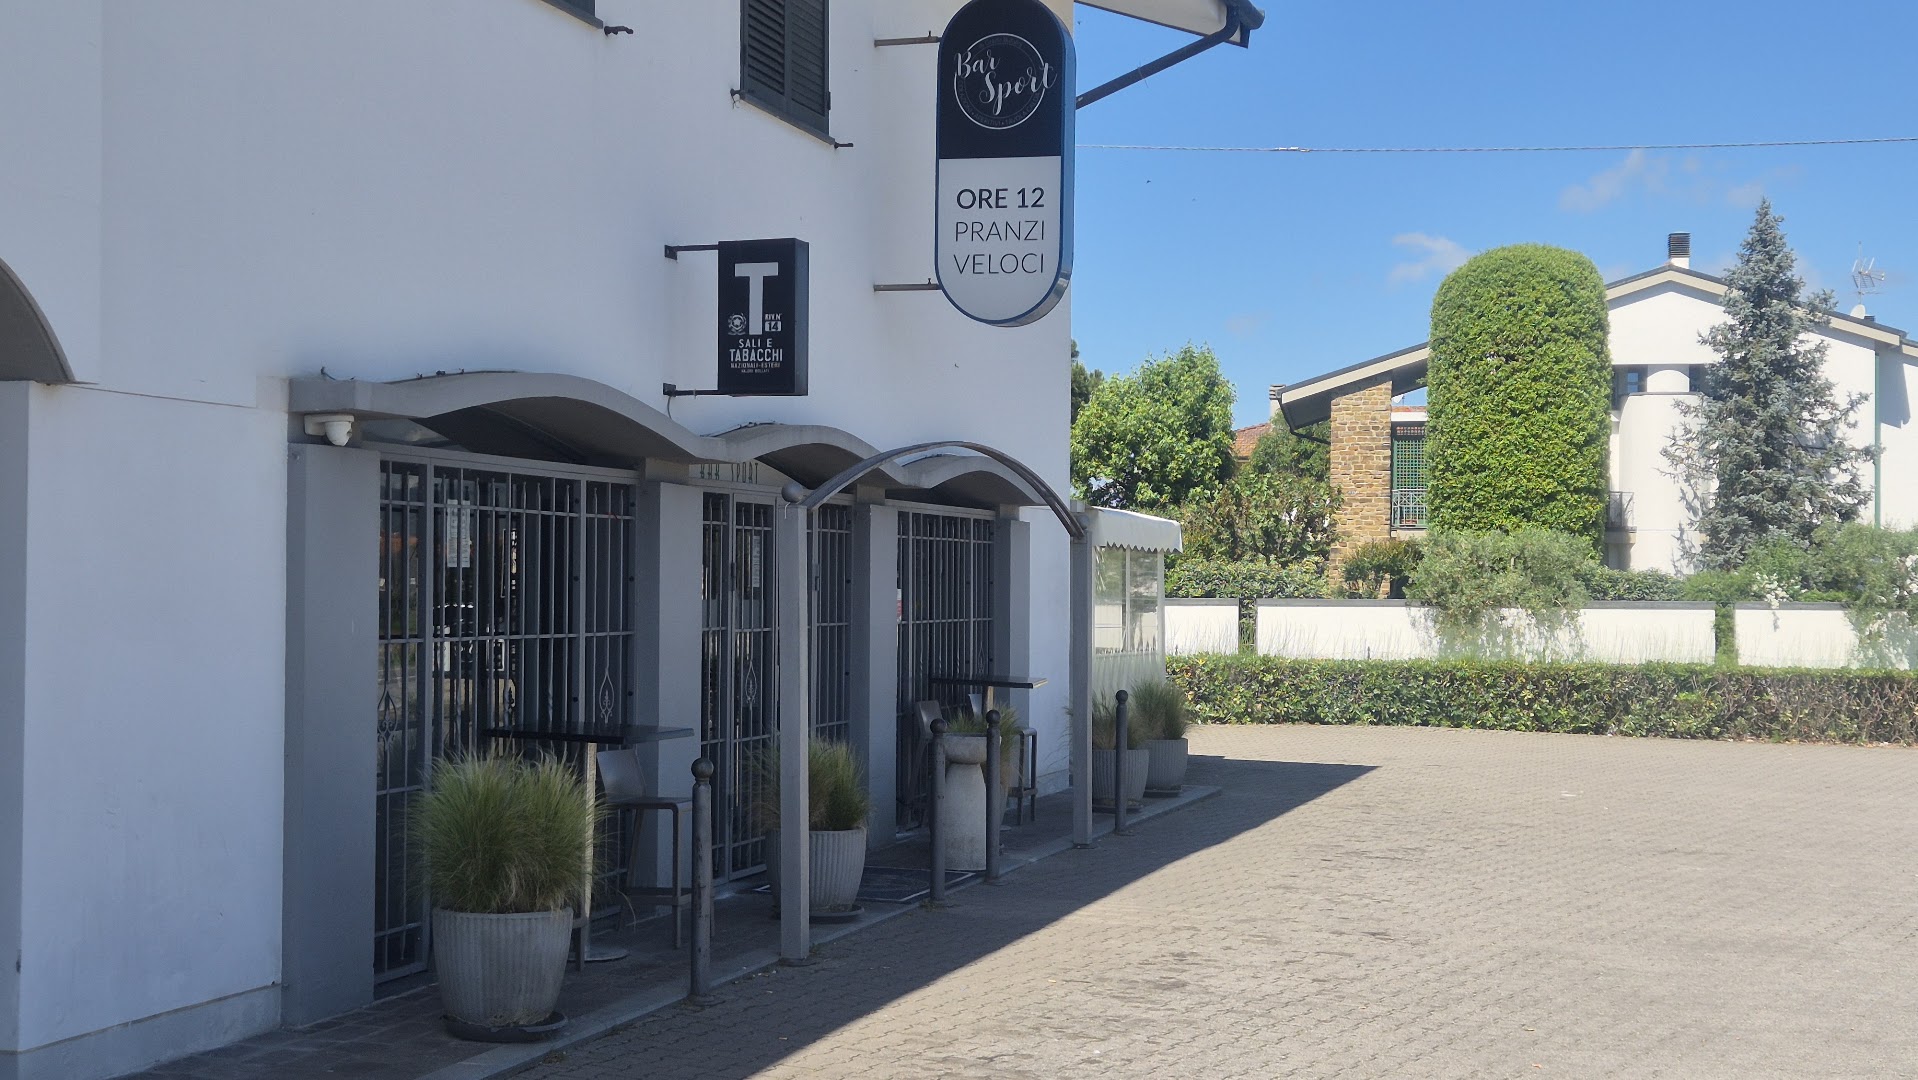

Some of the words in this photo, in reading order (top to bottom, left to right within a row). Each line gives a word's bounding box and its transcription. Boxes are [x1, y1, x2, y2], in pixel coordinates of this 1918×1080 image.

[954, 49, 1000, 78] Bar
[979, 62, 1057, 116] Sport
[956, 188, 1009, 210] ORE
[1017, 187, 1045, 209] 12
[955, 220, 1045, 242] PRANZI
[953, 252, 1044, 275] VELOCI
[734, 261, 779, 336] T
[766, 321, 780, 331] 14
[729, 348, 783, 362] TABACCHI
[738, 338, 761, 349] SALI
[766, 338, 773, 348] E
